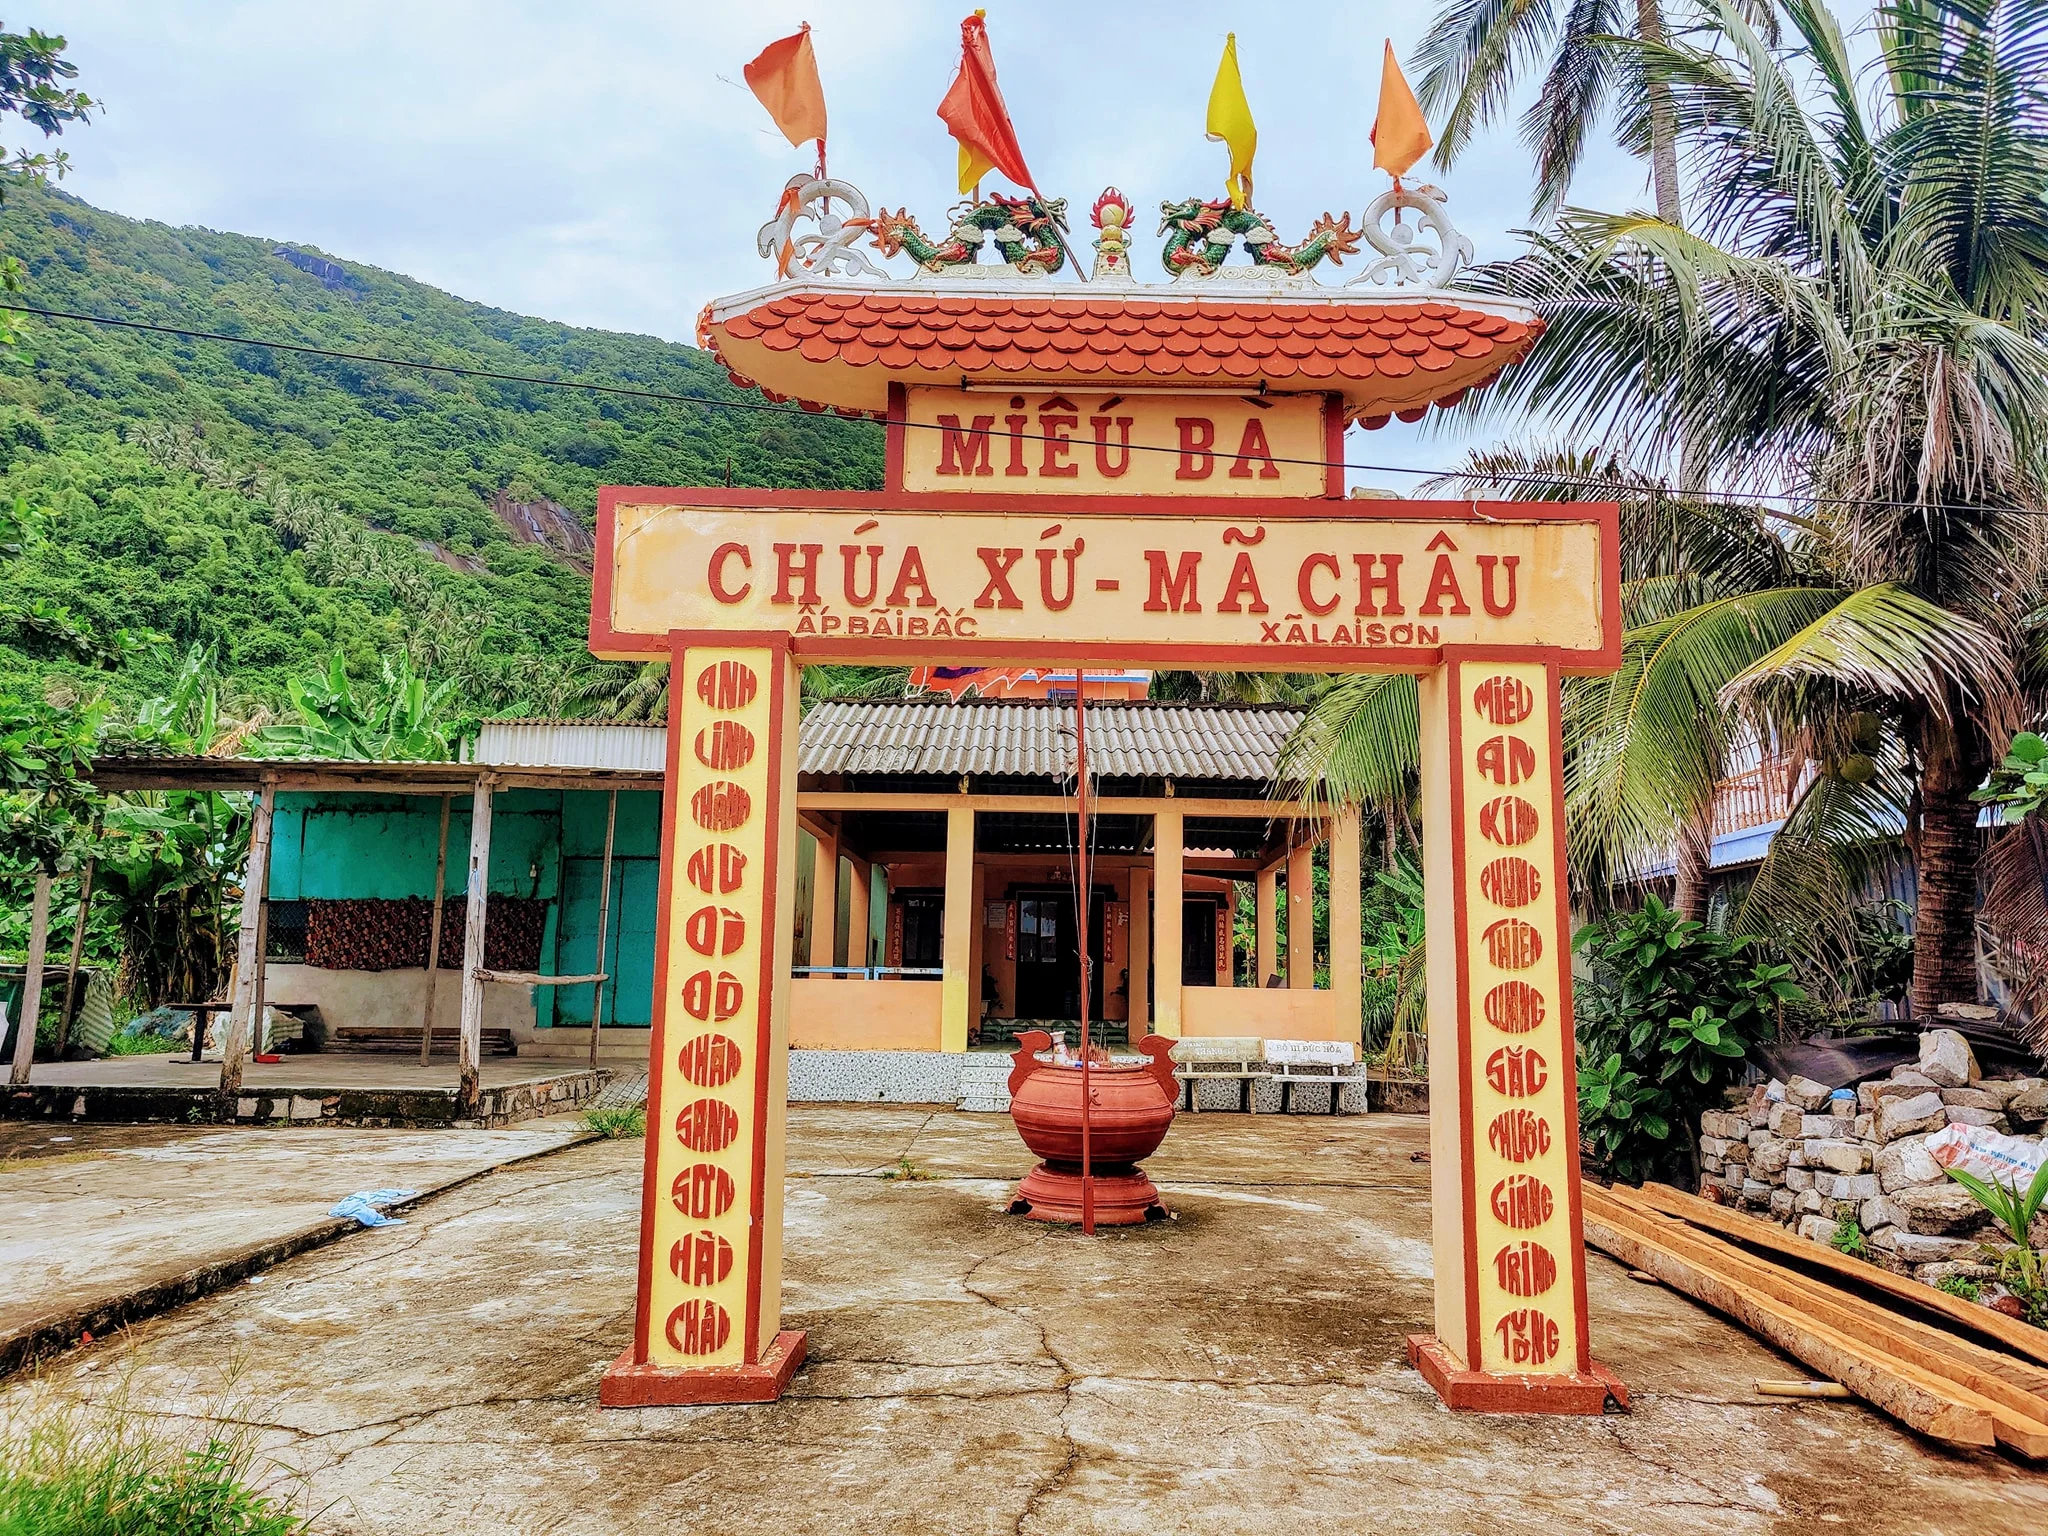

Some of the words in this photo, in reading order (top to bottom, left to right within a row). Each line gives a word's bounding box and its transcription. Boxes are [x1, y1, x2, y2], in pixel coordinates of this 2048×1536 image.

[935, 395, 1134, 479] MIẾU
[1174, 395, 1281, 480] BÀ
[707, 519, 938, 607] CHÚA
[973, 523, 1086, 611] XỨ
[1142, 525, 1270, 613] MÃ
[1297, 529, 1521, 617] CHÂU
[697, 660, 757, 711] ANH
[1473, 675, 1534, 725] MIẾU
[694, 720, 755, 771] LINH
[1479, 795, 1539, 846] KÍNH
[1480, 918, 1543, 971] THIÊN
[1486, 1044, 1548, 1098] SẮC
[676, 1098, 739, 1152] SANH
[671, 1163, 736, 1220] SƠN
[1490, 1173, 1554, 1230] GIÁNG
